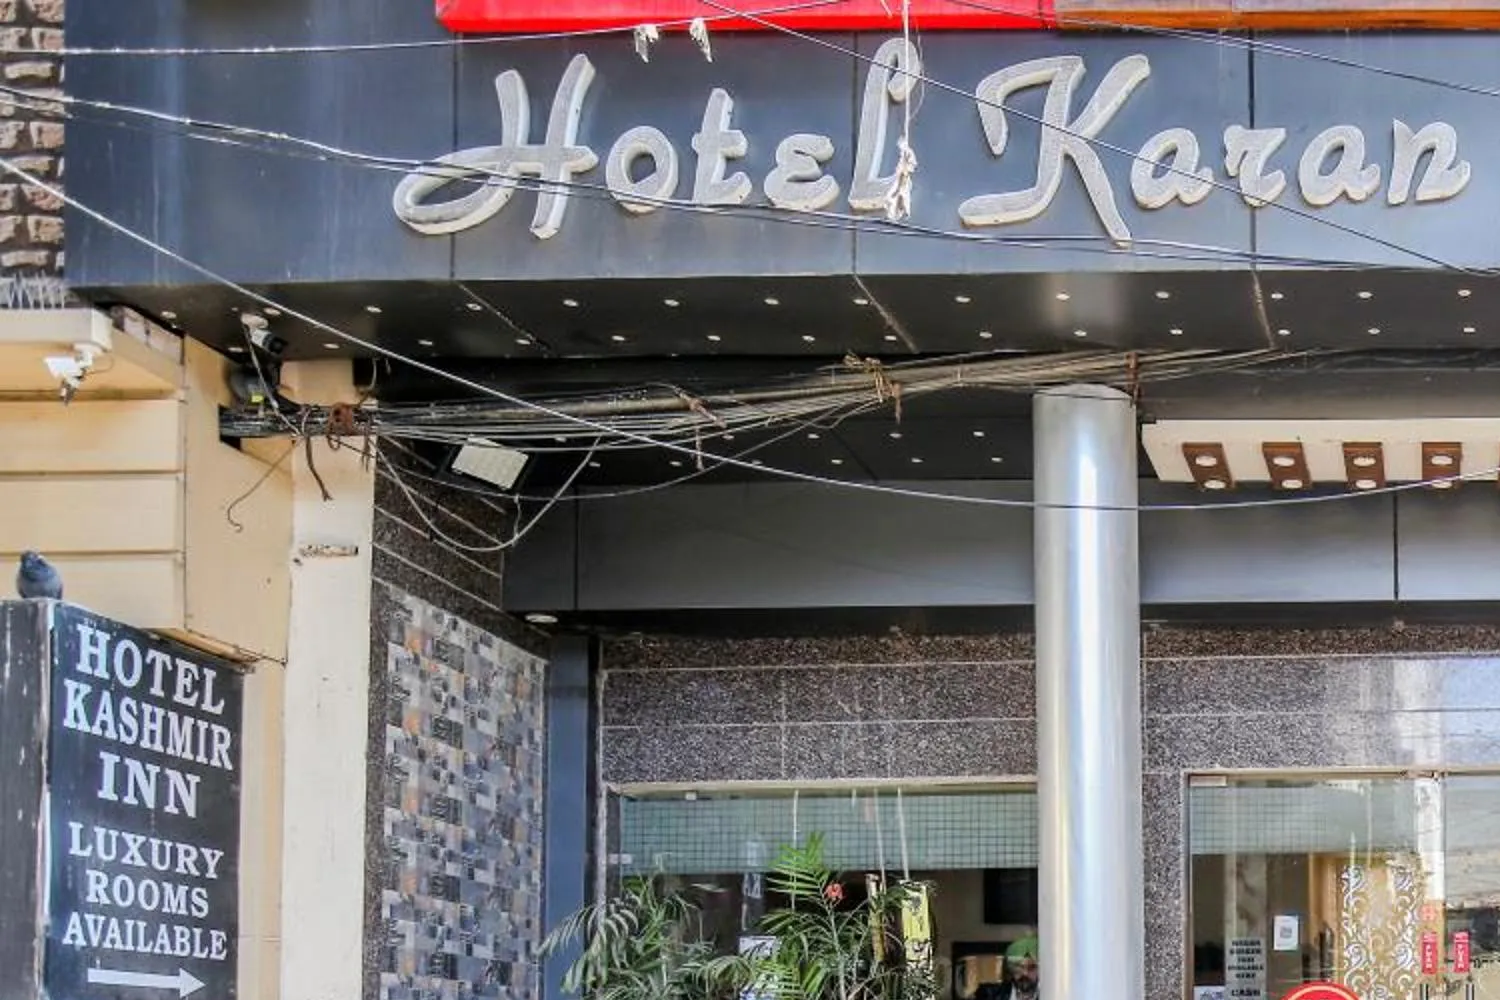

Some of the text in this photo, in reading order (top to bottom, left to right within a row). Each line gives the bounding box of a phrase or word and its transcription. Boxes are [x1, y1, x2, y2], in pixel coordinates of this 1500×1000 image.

[393, 37, 918, 239] Hotel
[958, 54, 1471, 248] Karan
[75, 623, 225, 716] HOTEL
[62, 679, 234, 771] KASHMIR
[97, 752, 201, 819] INN
[68, 821, 225, 880] LUXURY
[86, 870, 209, 918] ROOMS
[62, 911, 228, 961] AVAILABLE
